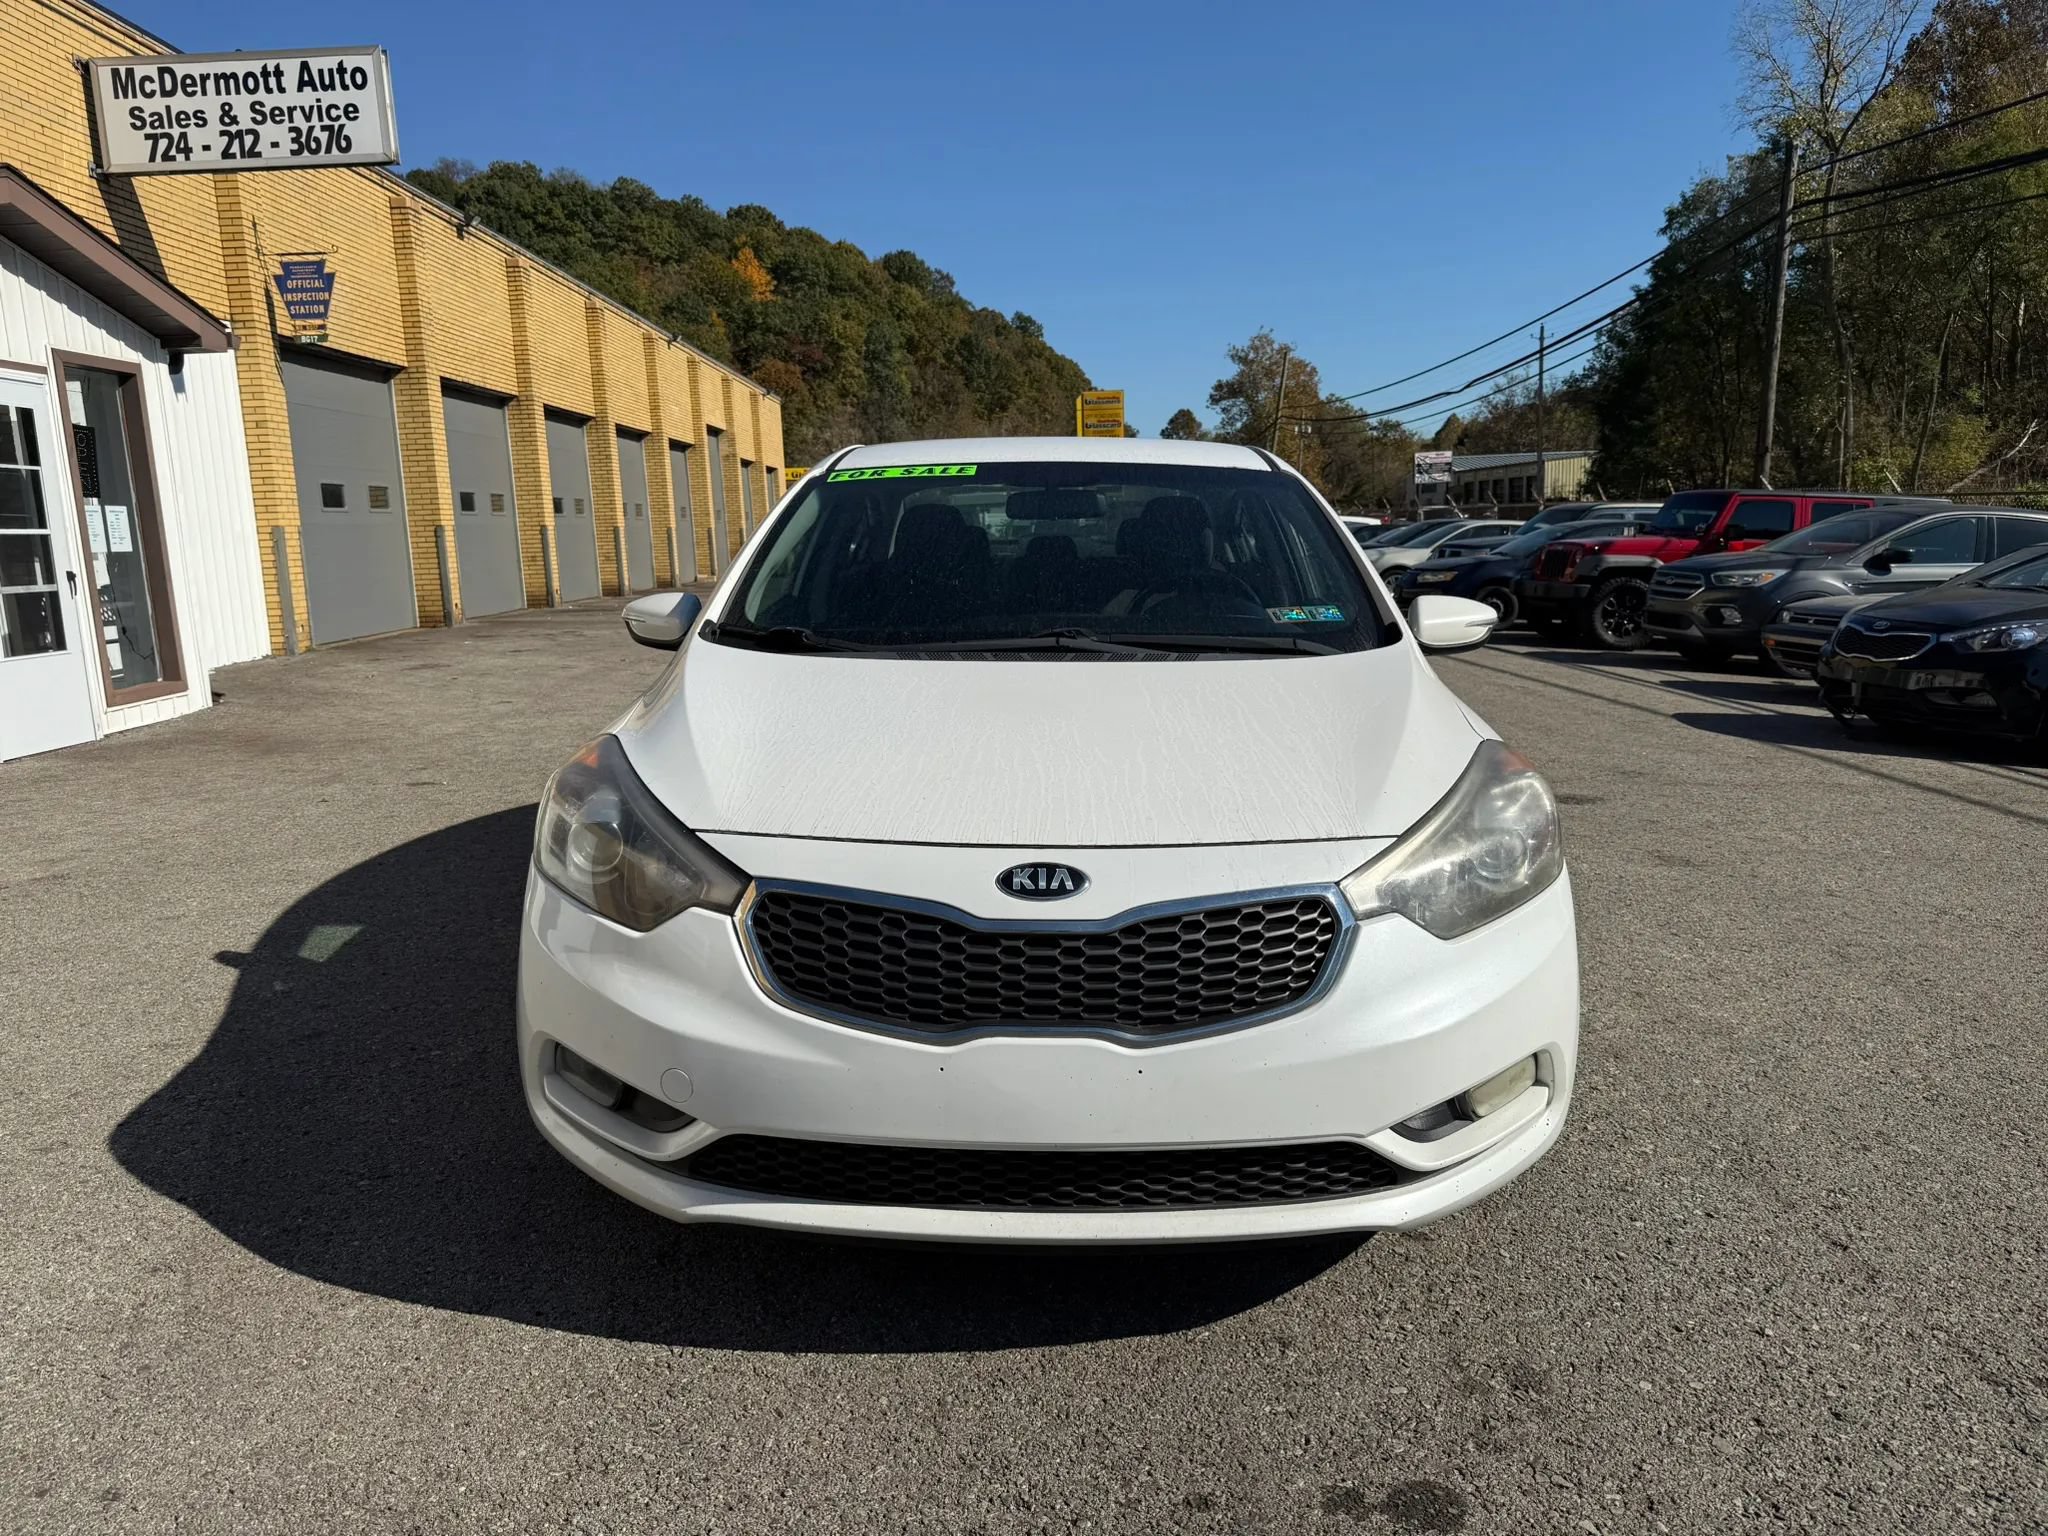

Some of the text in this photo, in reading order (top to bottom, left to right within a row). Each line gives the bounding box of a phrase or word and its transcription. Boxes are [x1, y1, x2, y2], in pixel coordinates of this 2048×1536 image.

[110, 59, 368, 100] McDermott Auto
[129, 98, 360, 131] Sales & Service
[143, 132, 193, 163] 724
[219, 128, 262, 160] 212
[288, 124, 352, 156] 3676
[286, 279, 325, 289] OFFICIAL
[283, 291, 330, 302] INSPECTION
[290, 305, 325, 314] STATION
[830, 466, 974, 481] FOR SALE
[1012, 867, 1074, 890] KIA
